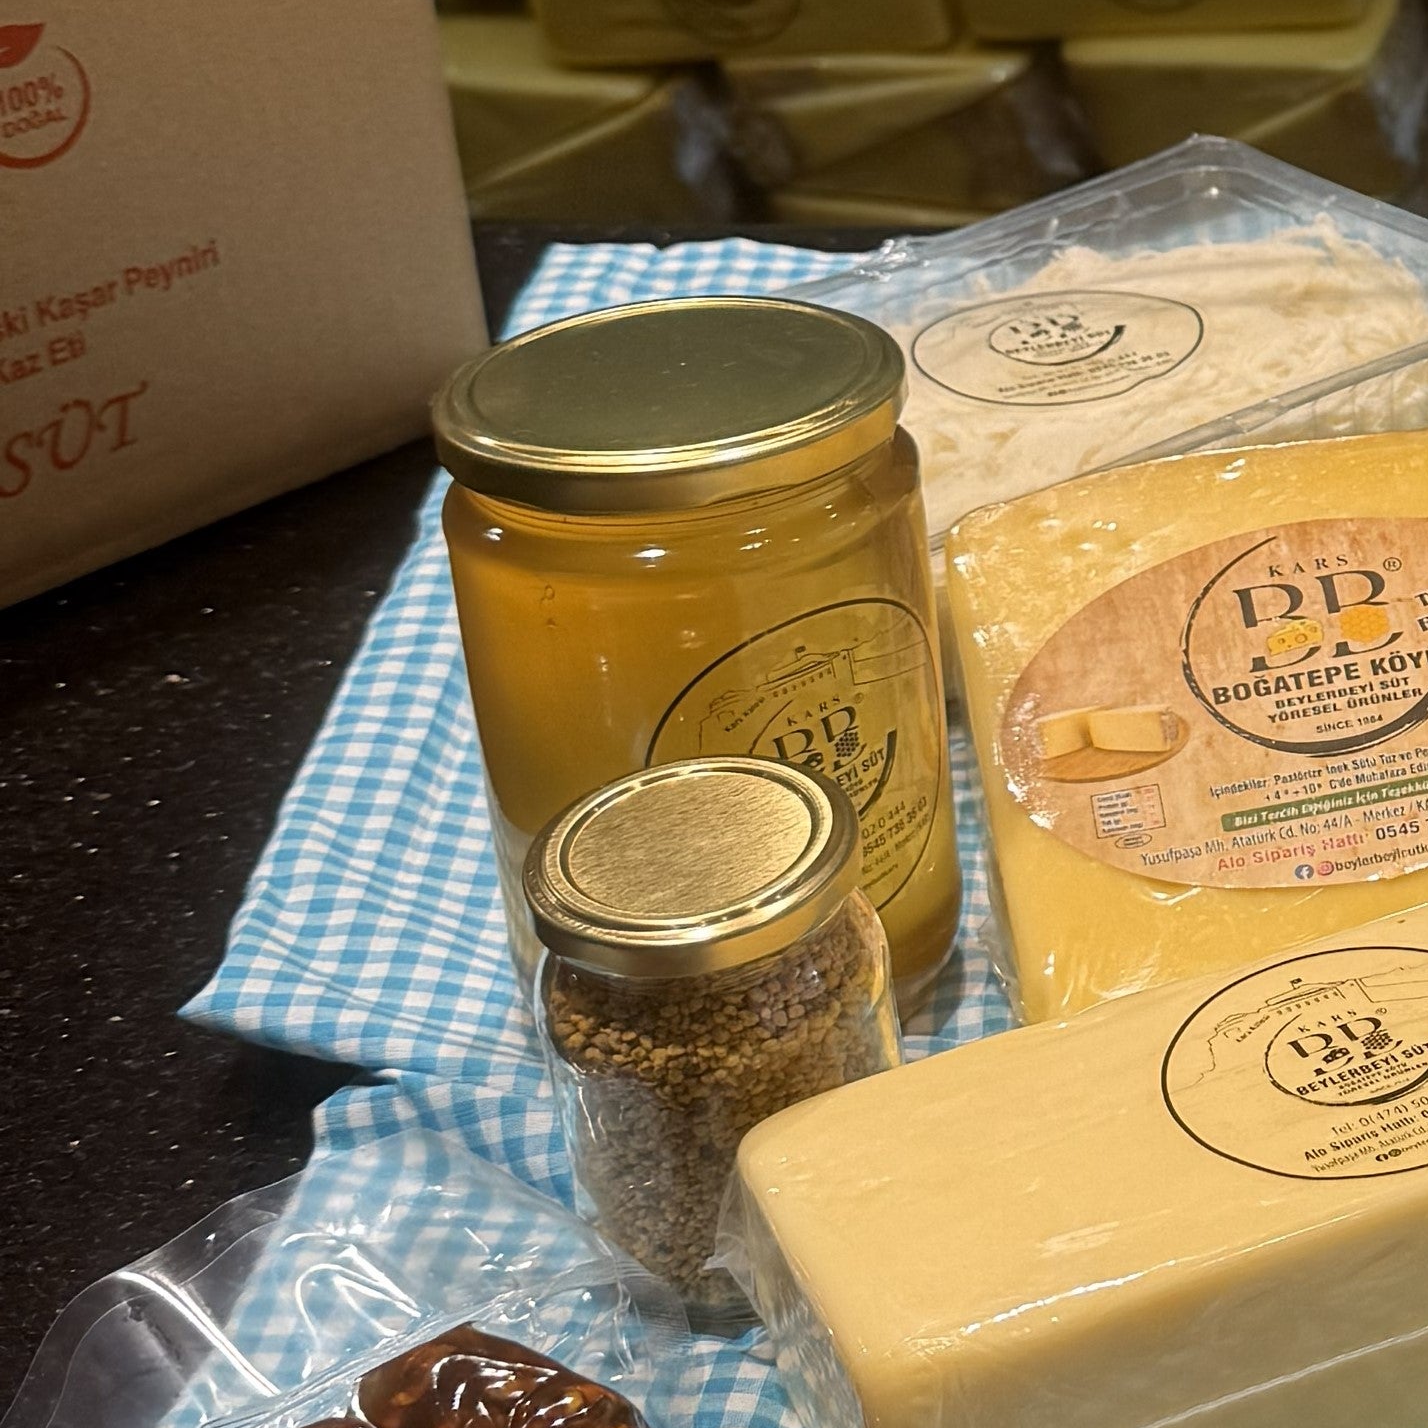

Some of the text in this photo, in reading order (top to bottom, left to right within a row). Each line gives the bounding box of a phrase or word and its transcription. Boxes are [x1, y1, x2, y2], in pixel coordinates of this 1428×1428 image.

[36, 281, 118, 326] Kaşar
[1269, 555, 1348, 577] KARS
[1213, 662, 1360, 704] BOĞATEPE
[1380, 677, 1409, 690] SÜT
[1268, 688, 1422, 723] YÖRESEL ÜRÜNLER
[862, 748, 884, 772] SÜT
[1232, 830, 1277, 849] Atatürk
[1323, 815, 1353, 832] 44/A
[1363, 806, 1405, 822] Merkez
[1217, 855, 1245, 872] Alo
[1253, 845, 1315, 864] Sipariş
[1376, 822, 1420, 840] 0545
[1296, 1054, 1398, 1095] BEYLERBEYİ
[1304, 1148, 1326, 1161] Alo
